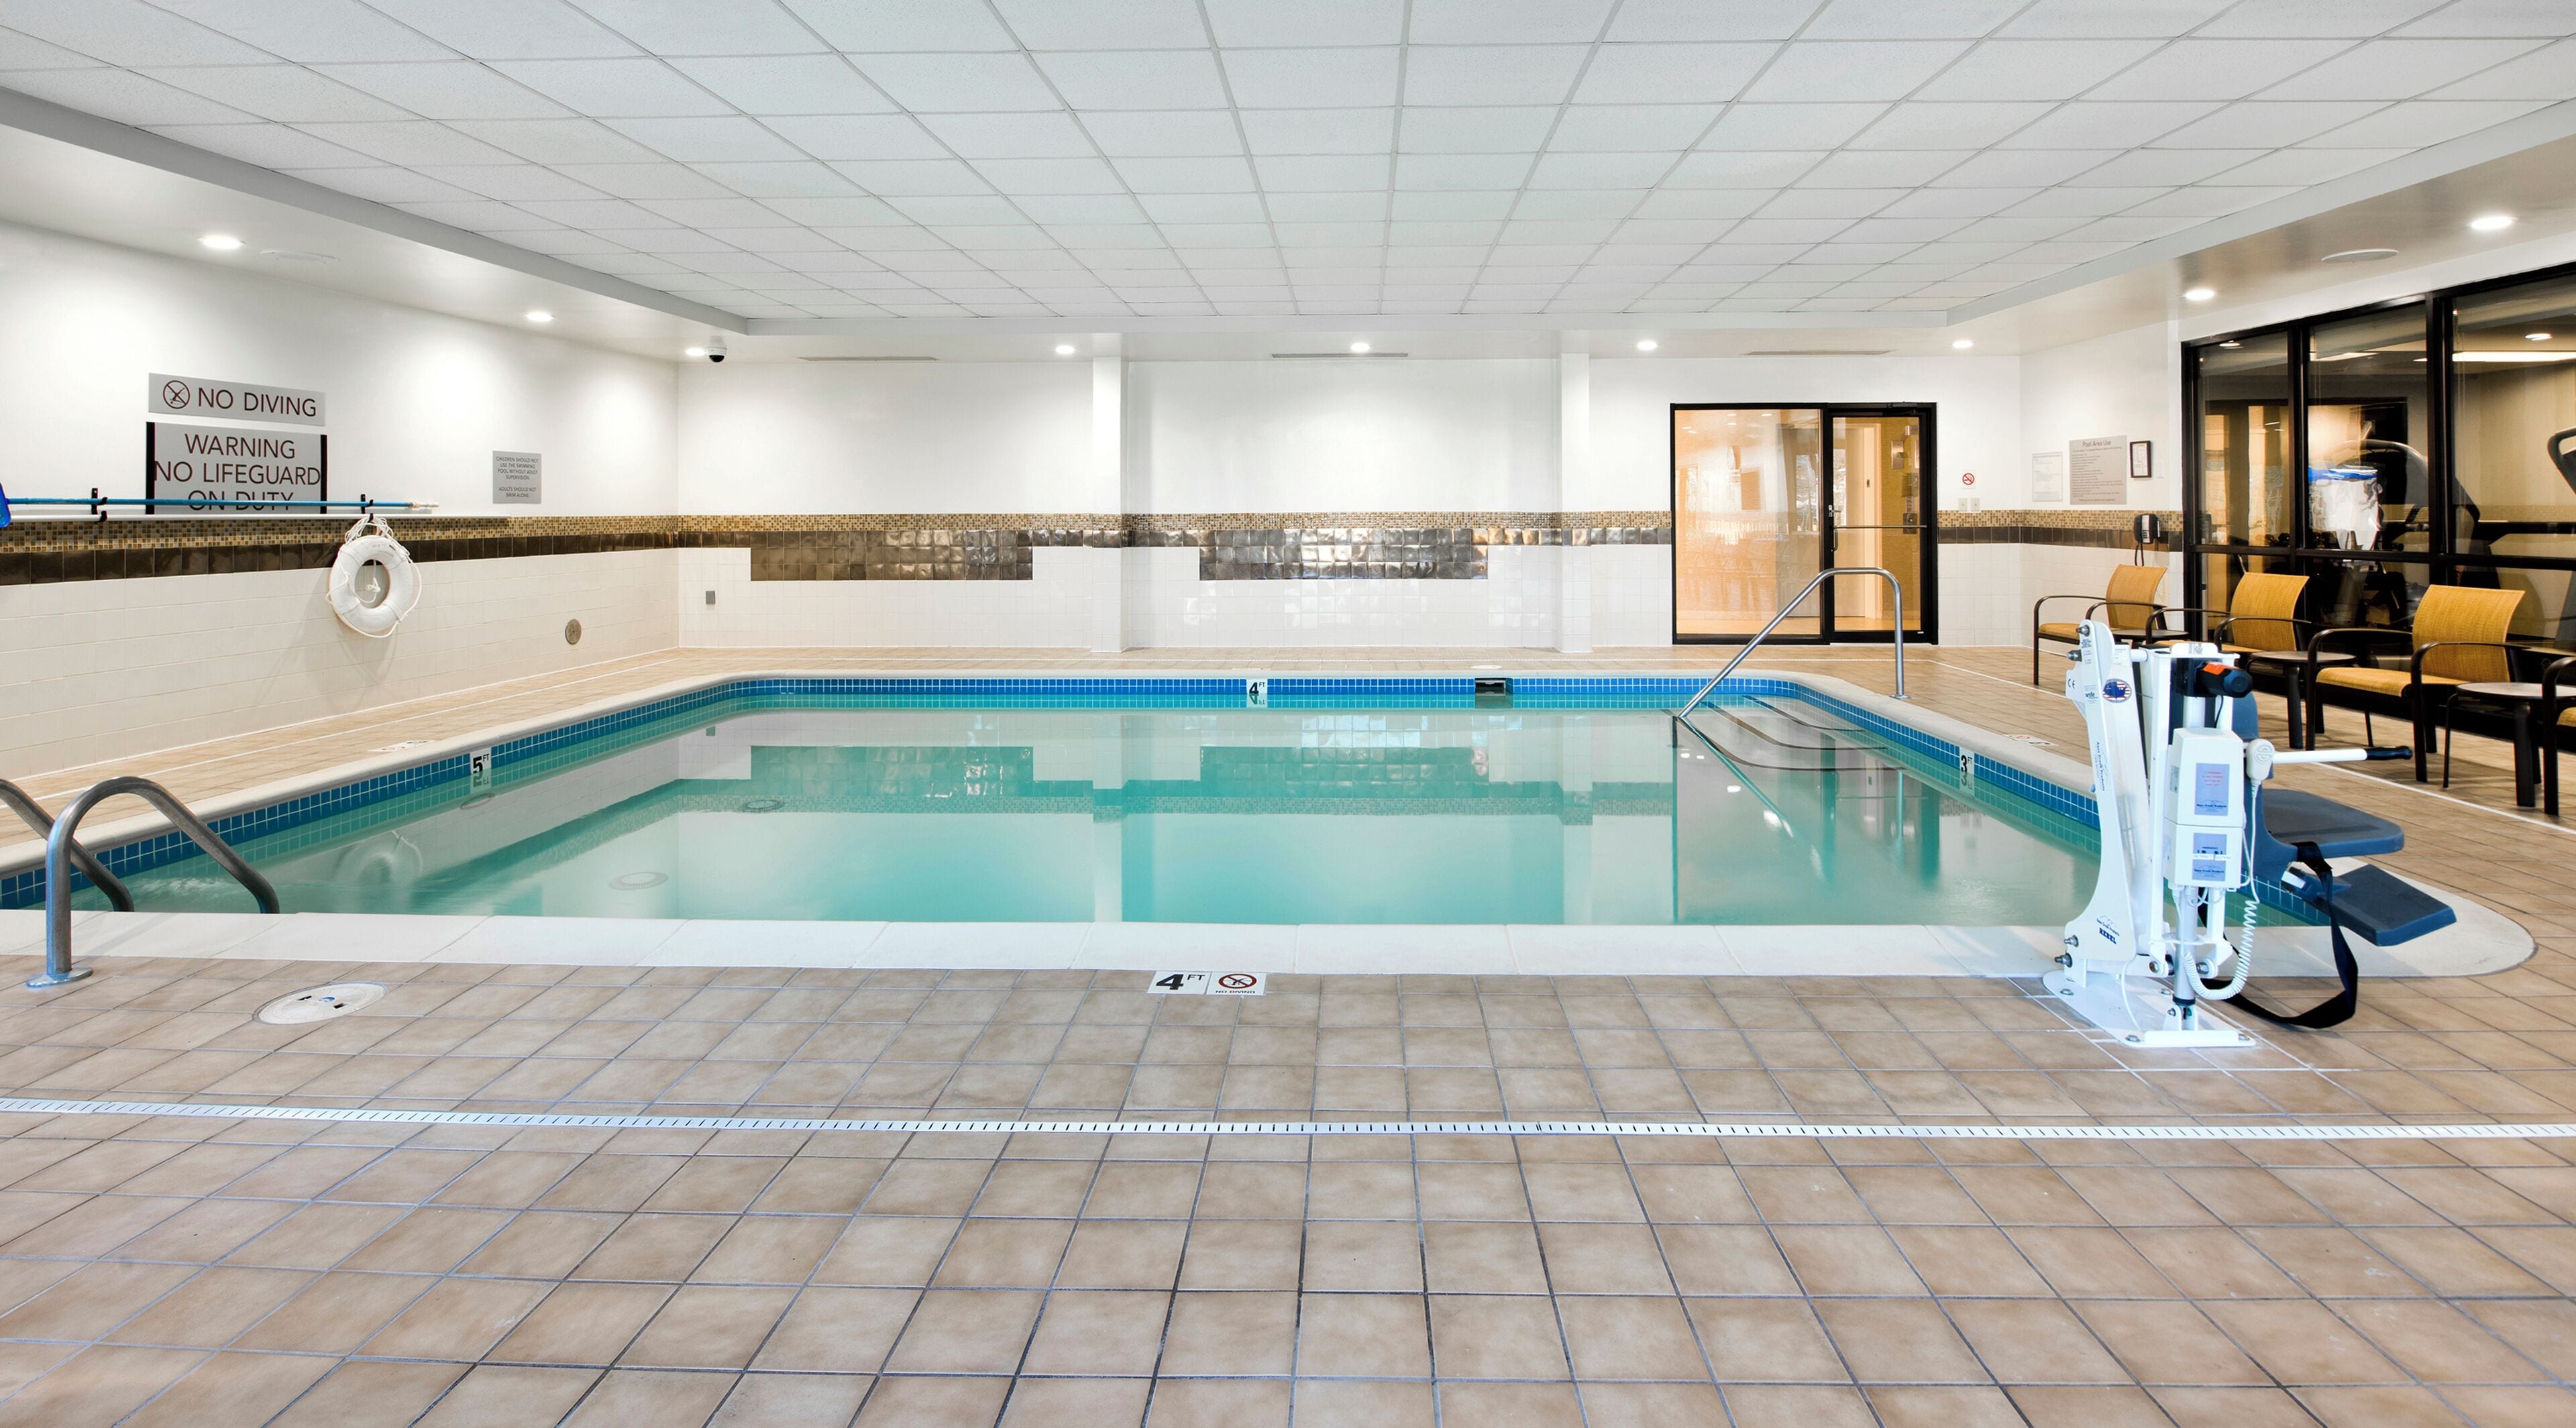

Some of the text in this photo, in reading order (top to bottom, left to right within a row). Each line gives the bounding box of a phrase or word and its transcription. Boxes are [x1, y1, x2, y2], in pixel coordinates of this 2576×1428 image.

[199, 388, 317, 417] NO DIVING
[185, 433, 295, 459] WARNING
[154, 461, 321, 485] NO LIFEGUARD
[188, 490, 293, 510] ON DUTY
[1249, 682, 1258, 694] 4
[473, 753, 490, 773] 5 FT
[1962, 755, 1972, 773] 3 FT
[1155, 974, 1184, 991] 4
